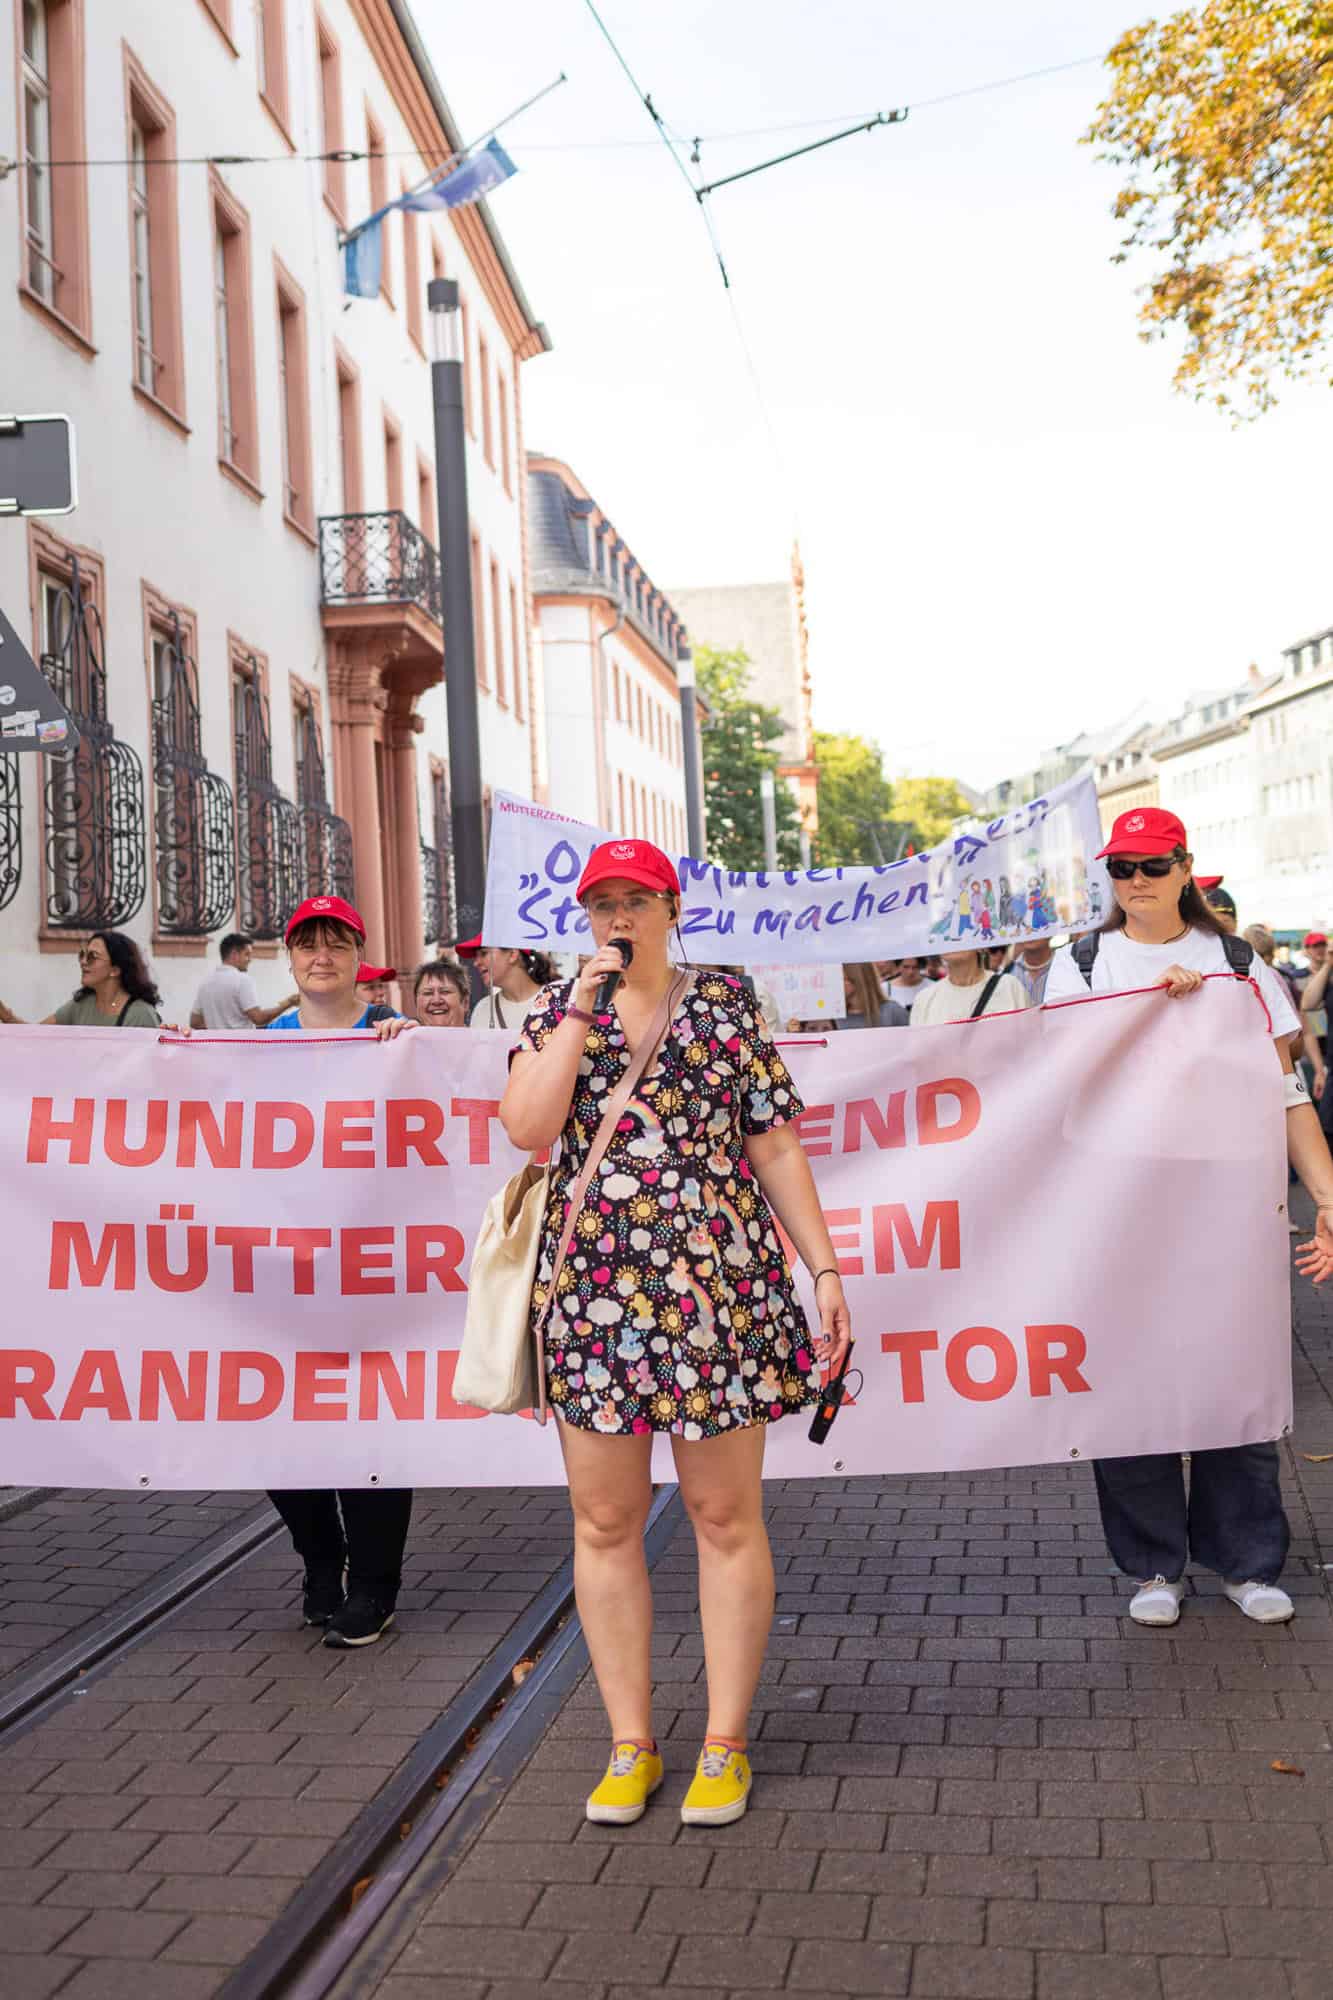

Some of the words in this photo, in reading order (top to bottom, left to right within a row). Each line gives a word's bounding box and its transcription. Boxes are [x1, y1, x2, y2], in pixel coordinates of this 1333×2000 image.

[518, 887, 591, 939] Sta
[680, 906, 735, 935] zu
[48, 1204, 469, 1296] MÜTTER
[770, 1199, 962, 1276] EM
[880, 1323, 1093, 1404] TOR
